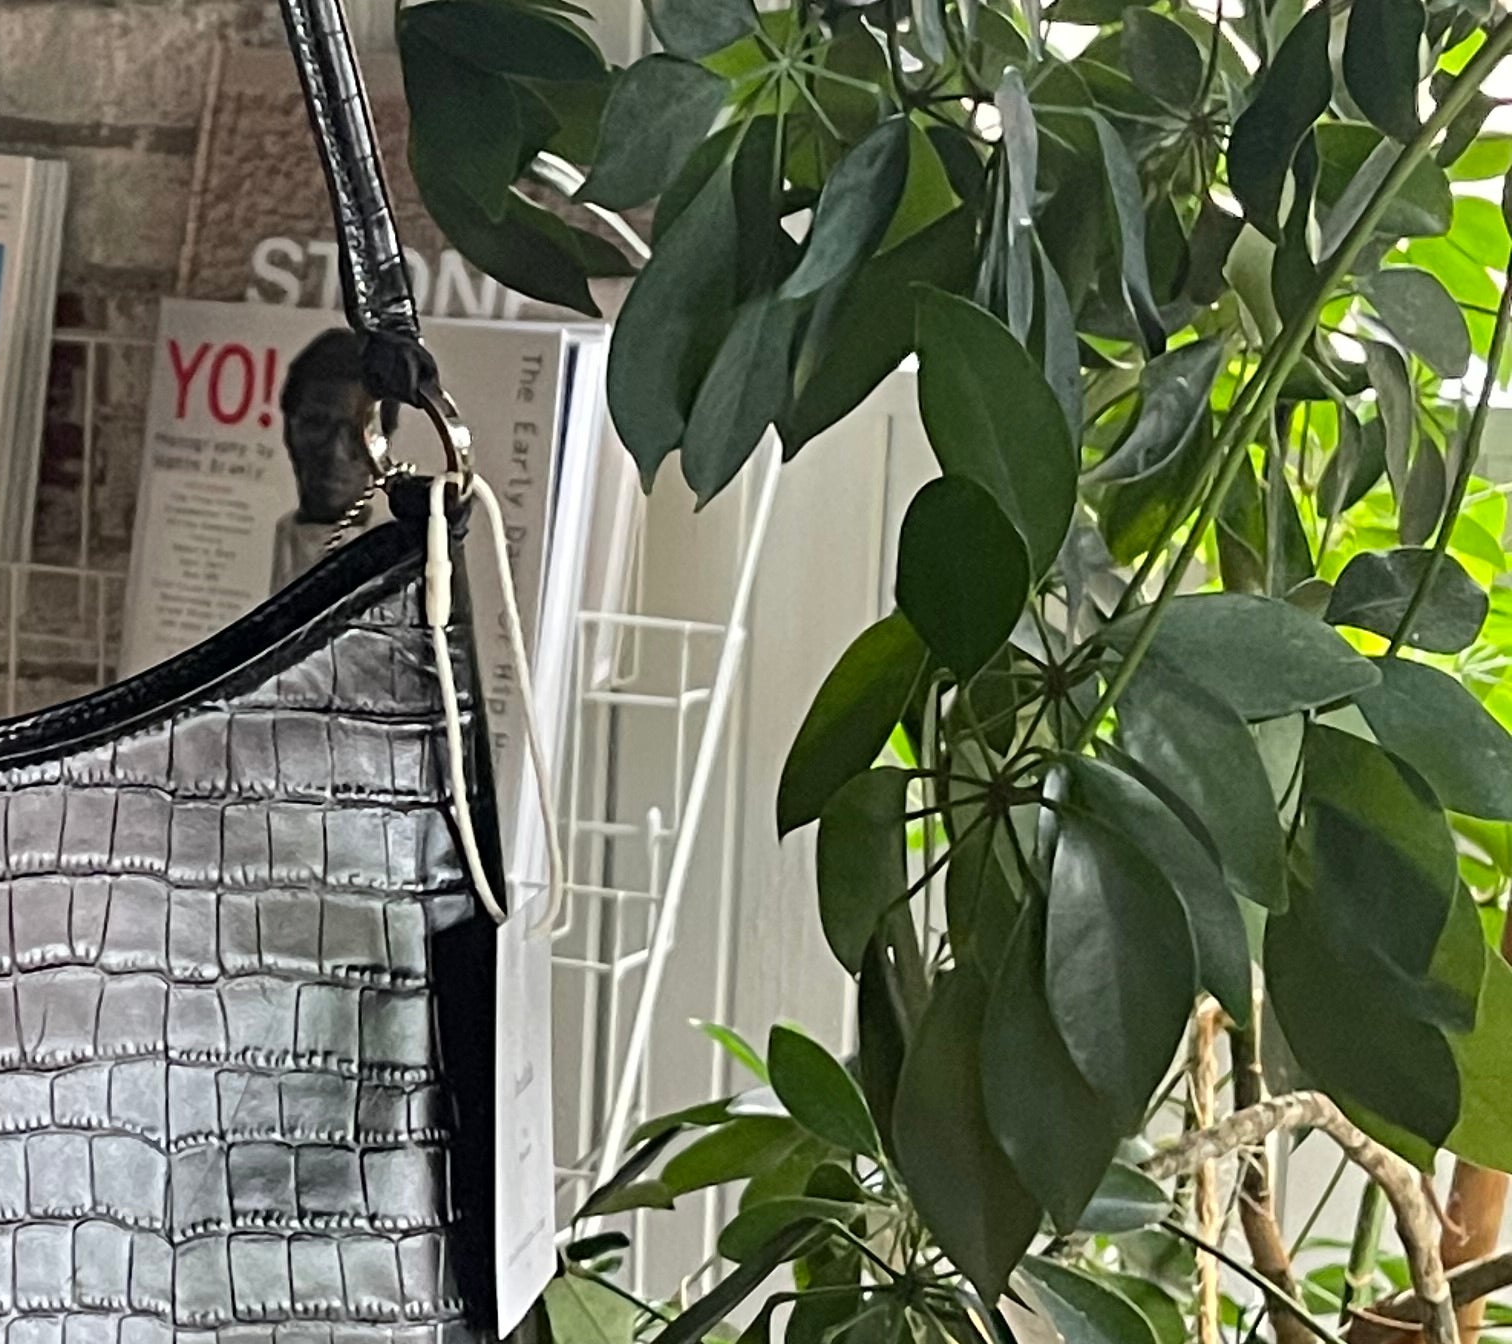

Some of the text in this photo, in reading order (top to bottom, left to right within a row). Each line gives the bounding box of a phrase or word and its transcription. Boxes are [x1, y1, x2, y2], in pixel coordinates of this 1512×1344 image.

[245, 236, 520, 320] STN
[167, 338, 277, 429] YO!
[516, 355, 542, 403] The
[503, 421, 536, 508] Early
